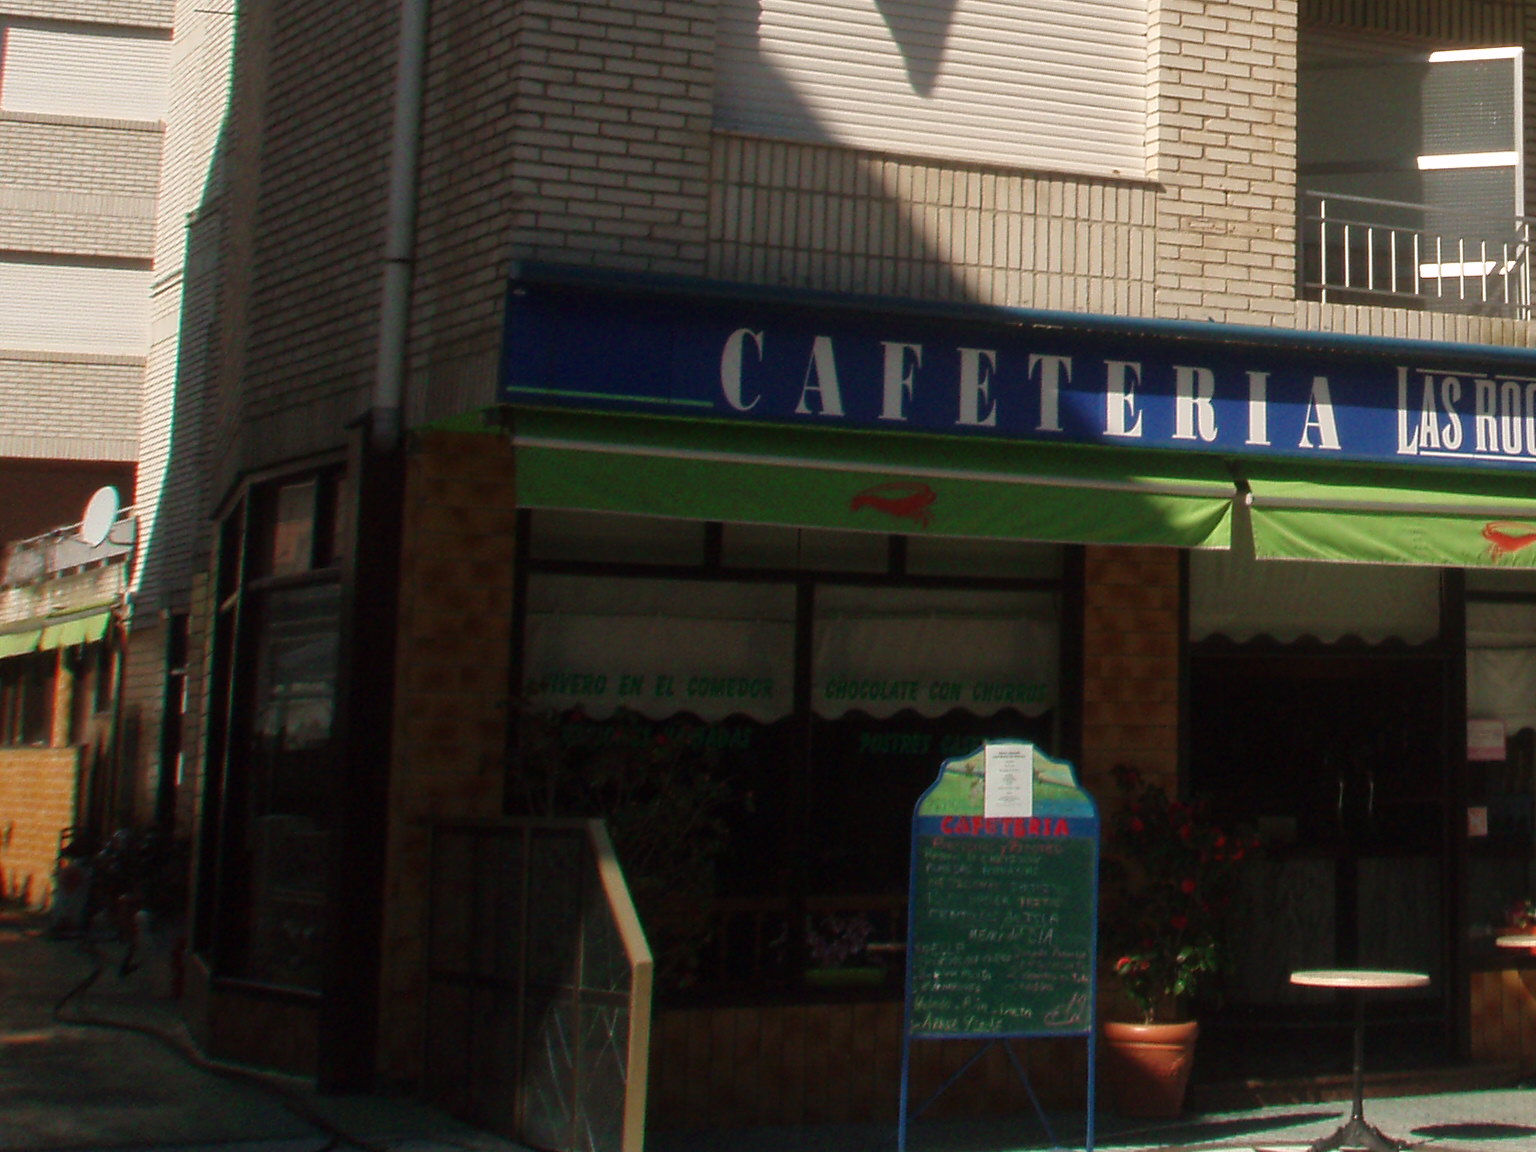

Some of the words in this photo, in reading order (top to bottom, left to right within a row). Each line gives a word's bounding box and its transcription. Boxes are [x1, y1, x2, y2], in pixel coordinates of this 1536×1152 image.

[720, 328, 1342, 450] CAFETERIA
[1397, 366, 1462, 456] LAS
[823, 678, 920, 701] CHOCOLATE
[927, 680, 965, 702] CON
[940, 815, 1070, 838] CAFETERIA
